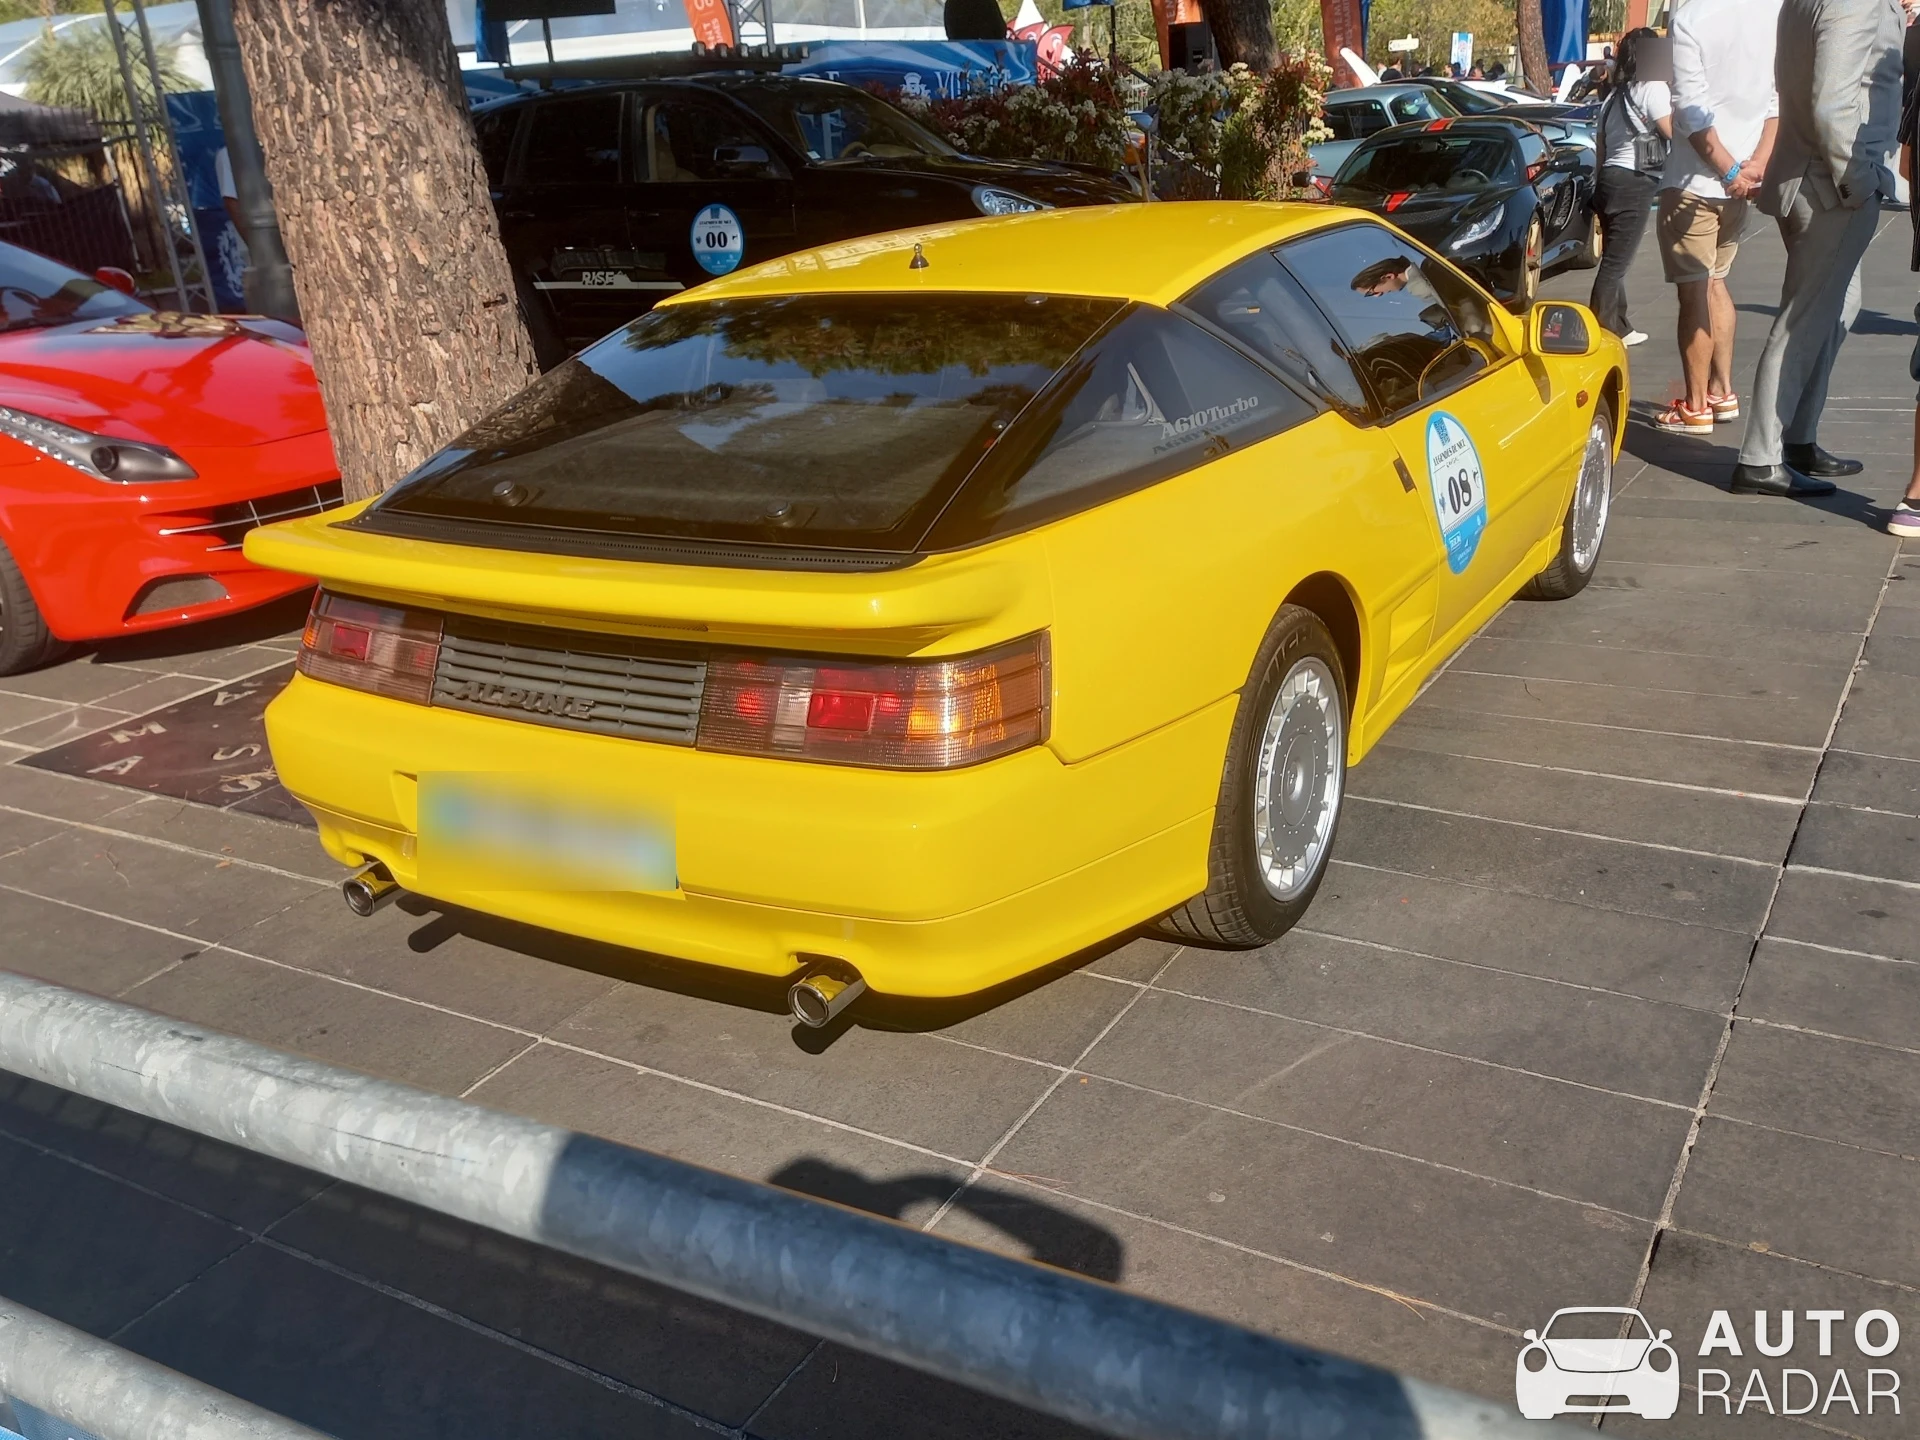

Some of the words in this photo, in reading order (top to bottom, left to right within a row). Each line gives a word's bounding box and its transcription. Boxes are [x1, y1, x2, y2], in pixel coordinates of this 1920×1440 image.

[706, 231, 728, 249] 00
[581, 271, 615, 286] RISE
[1448, 468, 1472, 514] 08
[453, 681, 596, 720] ALPINE
